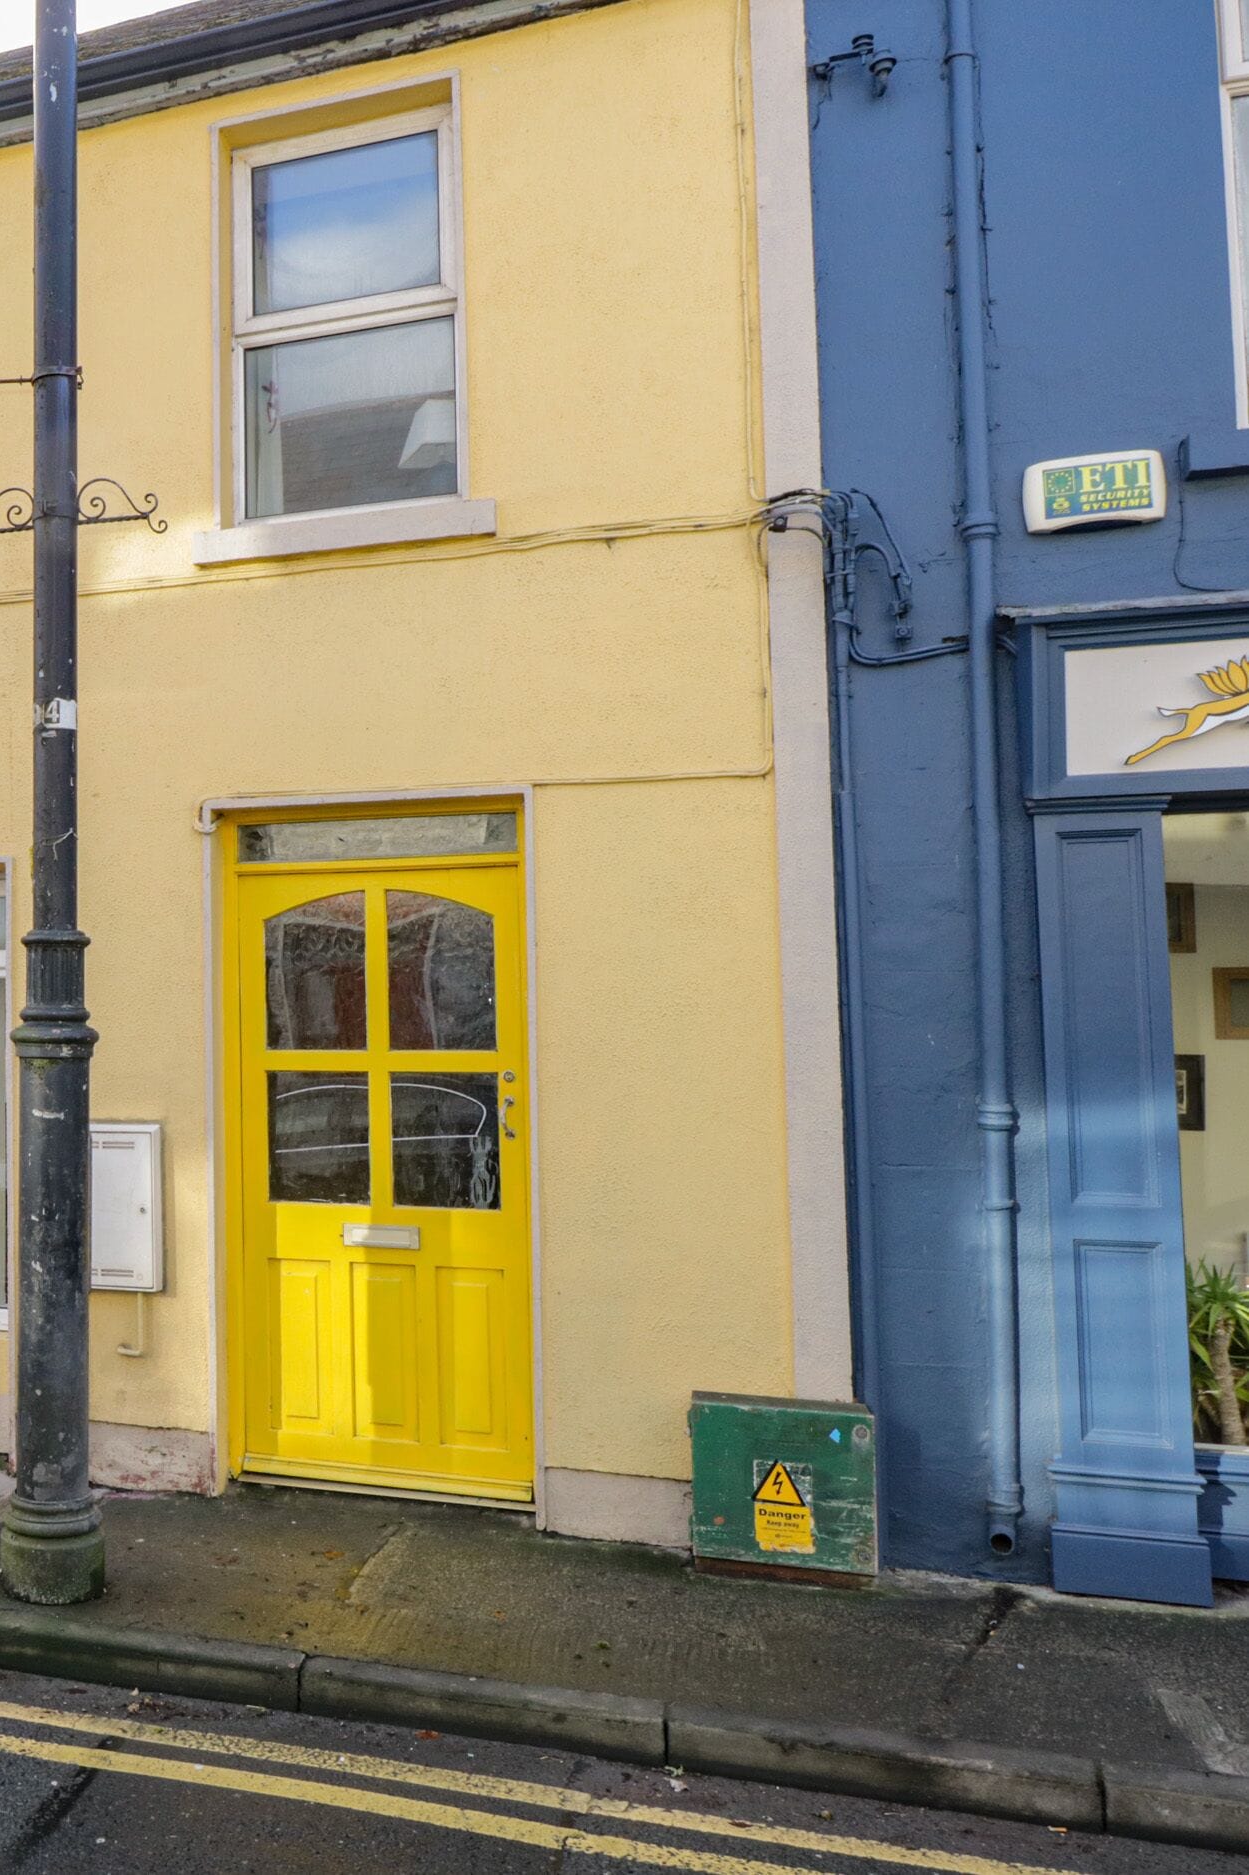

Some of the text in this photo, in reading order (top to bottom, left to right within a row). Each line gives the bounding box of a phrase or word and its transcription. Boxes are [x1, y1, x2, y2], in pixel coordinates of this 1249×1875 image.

[1079, 460, 1150, 492] ETI
[1080, 488, 1150, 502] SECURITY
[1082, 498, 1150, 512] SYSTEMS
[759, 1508, 806, 1520] Danger
